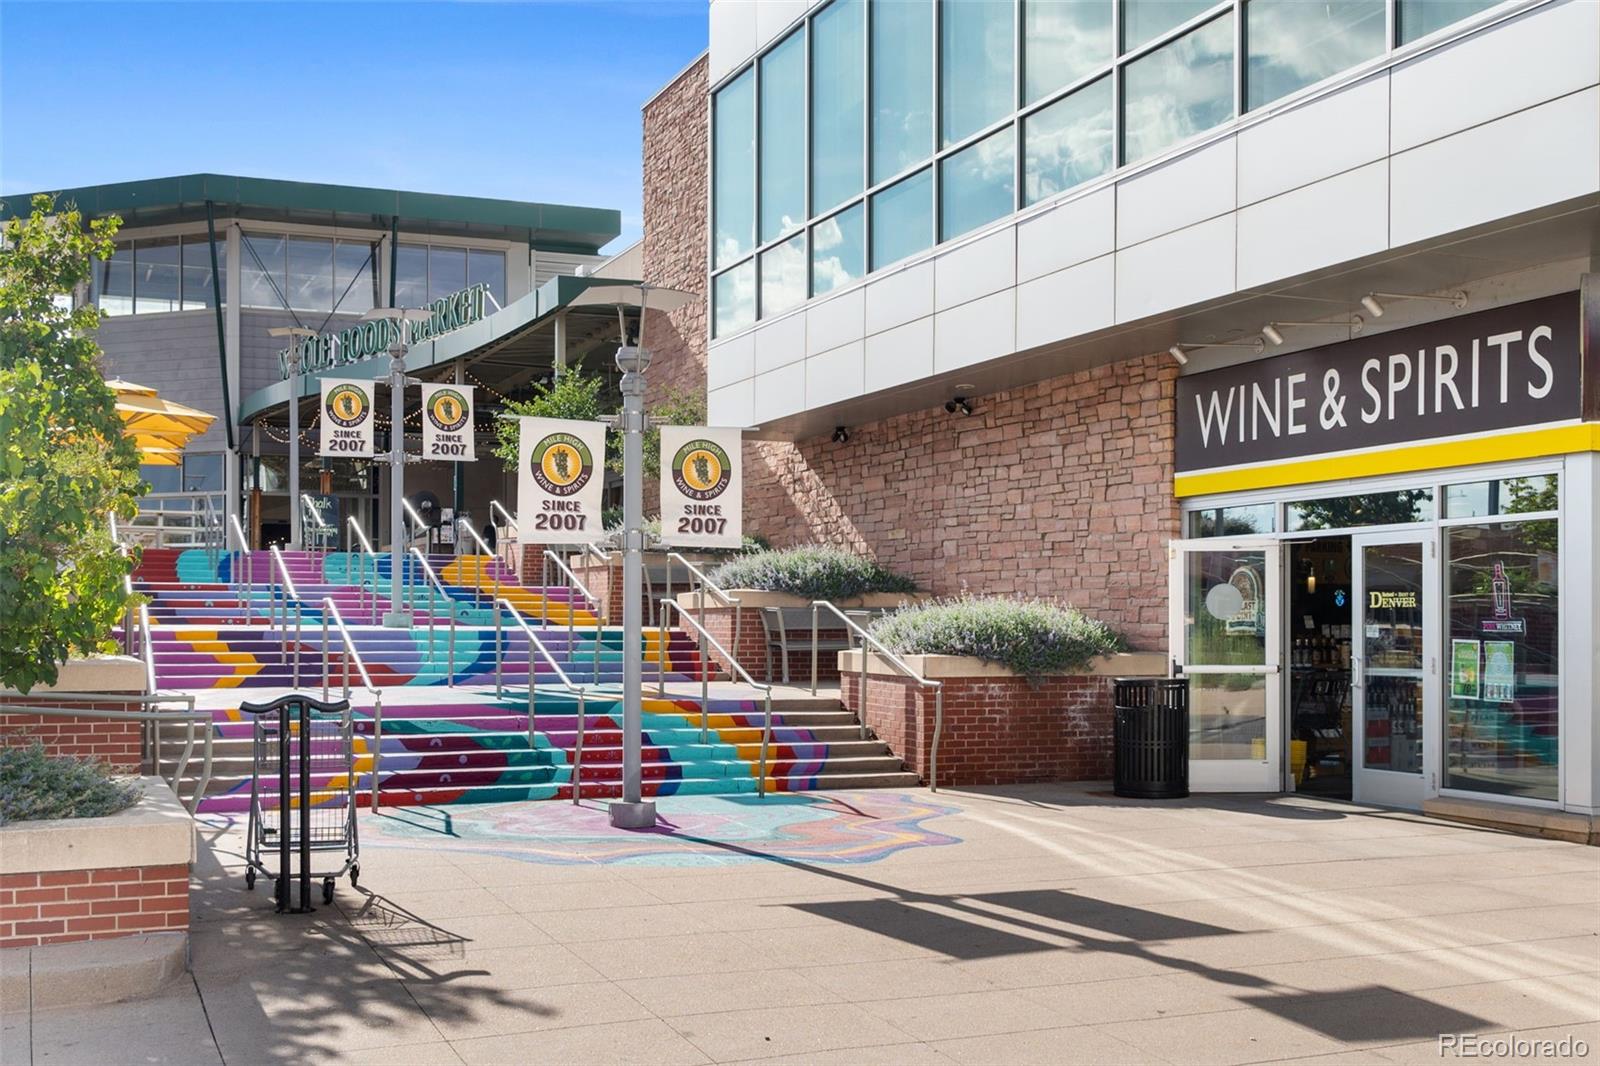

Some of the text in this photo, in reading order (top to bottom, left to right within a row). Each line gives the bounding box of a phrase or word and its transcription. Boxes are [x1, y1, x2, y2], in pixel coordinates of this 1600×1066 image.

[407, 283, 487, 345] MARKET
[1195, 325, 1554, 448] WINE & SPIRITS
[333, 430, 362, 439] SINCE
[435, 434, 463, 443] SINCE
[543, 435, 584, 449] MILE HIGH
[329, 439, 366, 452] 2007
[431, 443, 467, 456] 2007
[683, 441, 722, 456] MILE HIGH
[535, 470, 553, 491] WINE
[563, 474, 589, 494] SPIRITS
[675, 476, 694, 496] WINE
[705, 478, 728, 499] SPIRITS
[542, 500, 582, 512] SINCE
[684, 504, 722, 516] SINCE
[535, 513, 587, 531] 2007
[678, 517, 727, 534] 2007
[1369, 591, 1416, 608] DENVER
